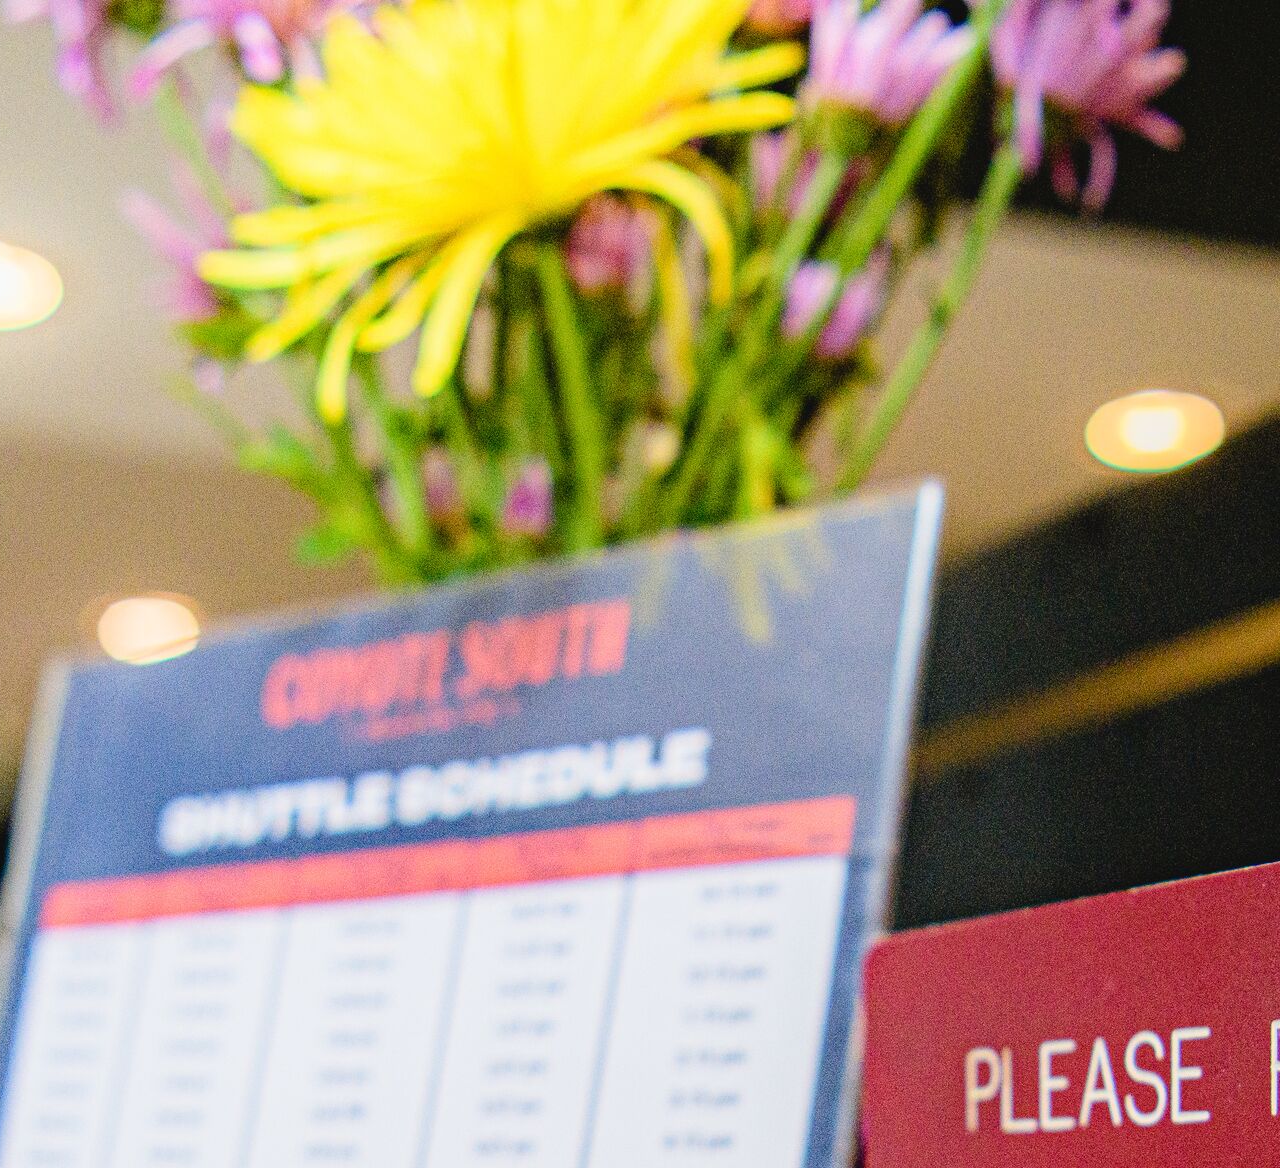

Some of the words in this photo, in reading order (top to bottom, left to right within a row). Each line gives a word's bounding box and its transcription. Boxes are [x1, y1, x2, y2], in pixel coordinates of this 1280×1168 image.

[162, 774, 393, 854] SHUTTLE
[399, 731, 709, 823] SCHEDULE
[965, 1026, 1212, 1134] PLEASE
